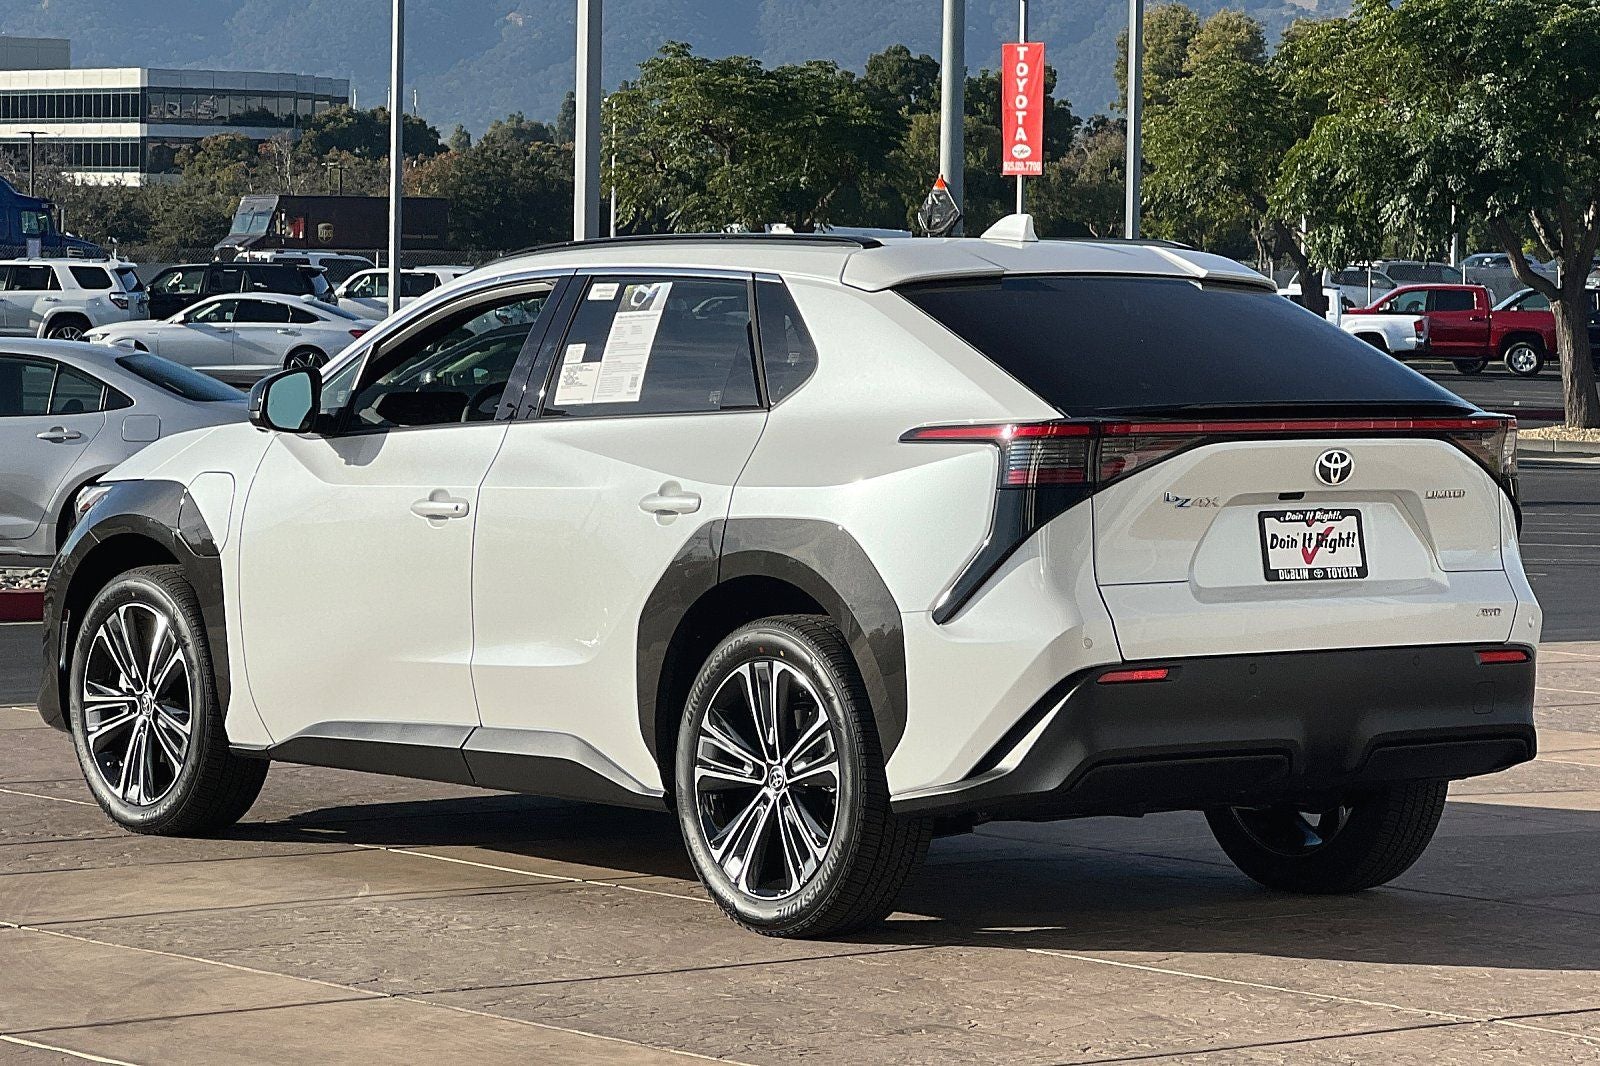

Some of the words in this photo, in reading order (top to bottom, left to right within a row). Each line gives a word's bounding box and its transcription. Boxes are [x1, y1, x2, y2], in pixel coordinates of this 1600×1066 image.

[1015, 46, 1029, 141] TOYOTA
[1306, 511, 1315, 520] It
[1270, 532, 1299, 549] Doin'
[1302, 532, 1313, 549] It
[1316, 532, 1356, 554] Right!
[1278, 568, 1309, 580] DUBLIN
[1326, 567, 1358, 579] TOYOTA
